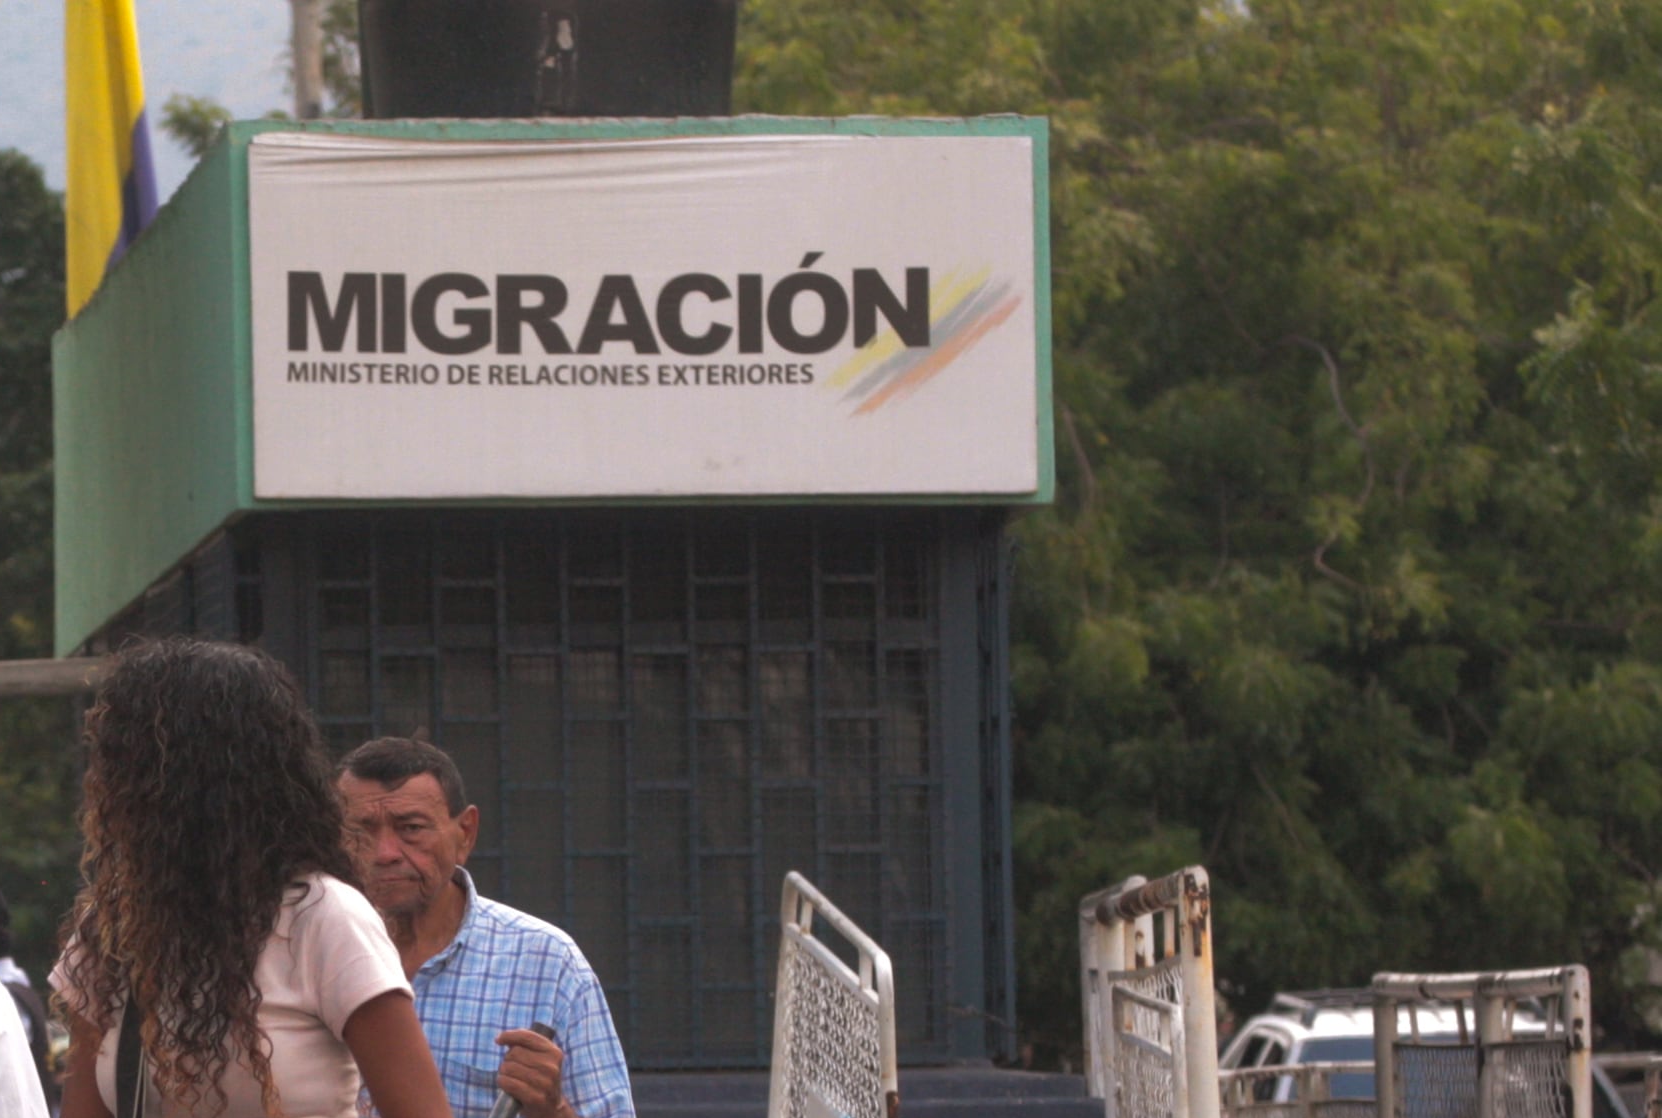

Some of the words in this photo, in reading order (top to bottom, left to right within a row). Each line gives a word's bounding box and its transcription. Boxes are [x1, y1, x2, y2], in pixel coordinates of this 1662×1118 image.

[287, 251, 931, 356] MIGRACIÓN
[287, 361, 439, 384] MINISTERIO
[446, 364, 481, 385] DE
[488, 364, 650, 386] RELACIONES
[657, 363, 814, 386] EXTERIORES
